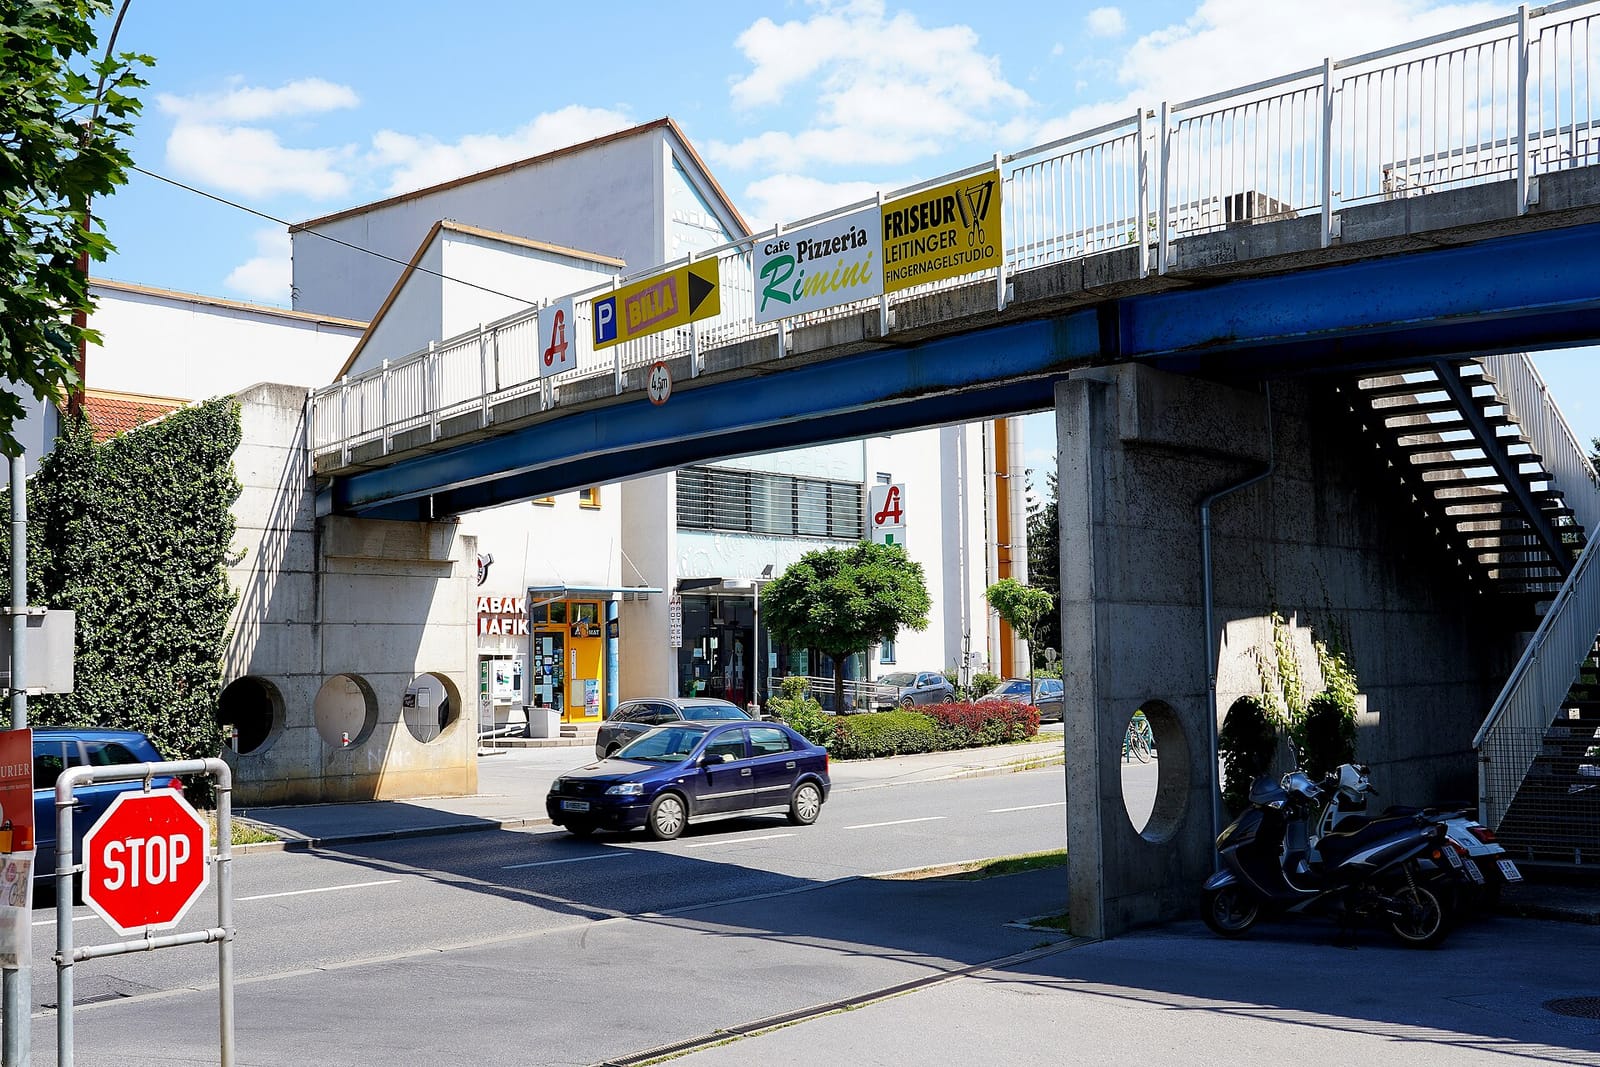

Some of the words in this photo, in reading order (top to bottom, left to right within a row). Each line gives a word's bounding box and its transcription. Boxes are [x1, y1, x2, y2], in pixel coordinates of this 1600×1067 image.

[885, 195, 955, 240] FRISEUR
[764, 240, 790, 255] Cafe
[797, 226, 867, 263] Pizzeria
[886, 229, 957, 264] LEITINGER
[886, 245, 994, 283] FINGERNAGELSTUDIO
[760, 251, 873, 312] Rimini
[598, 303, 612, 339] P
[628, 282, 675, 329] BILLA
[103, 833, 191, 891] STOP
